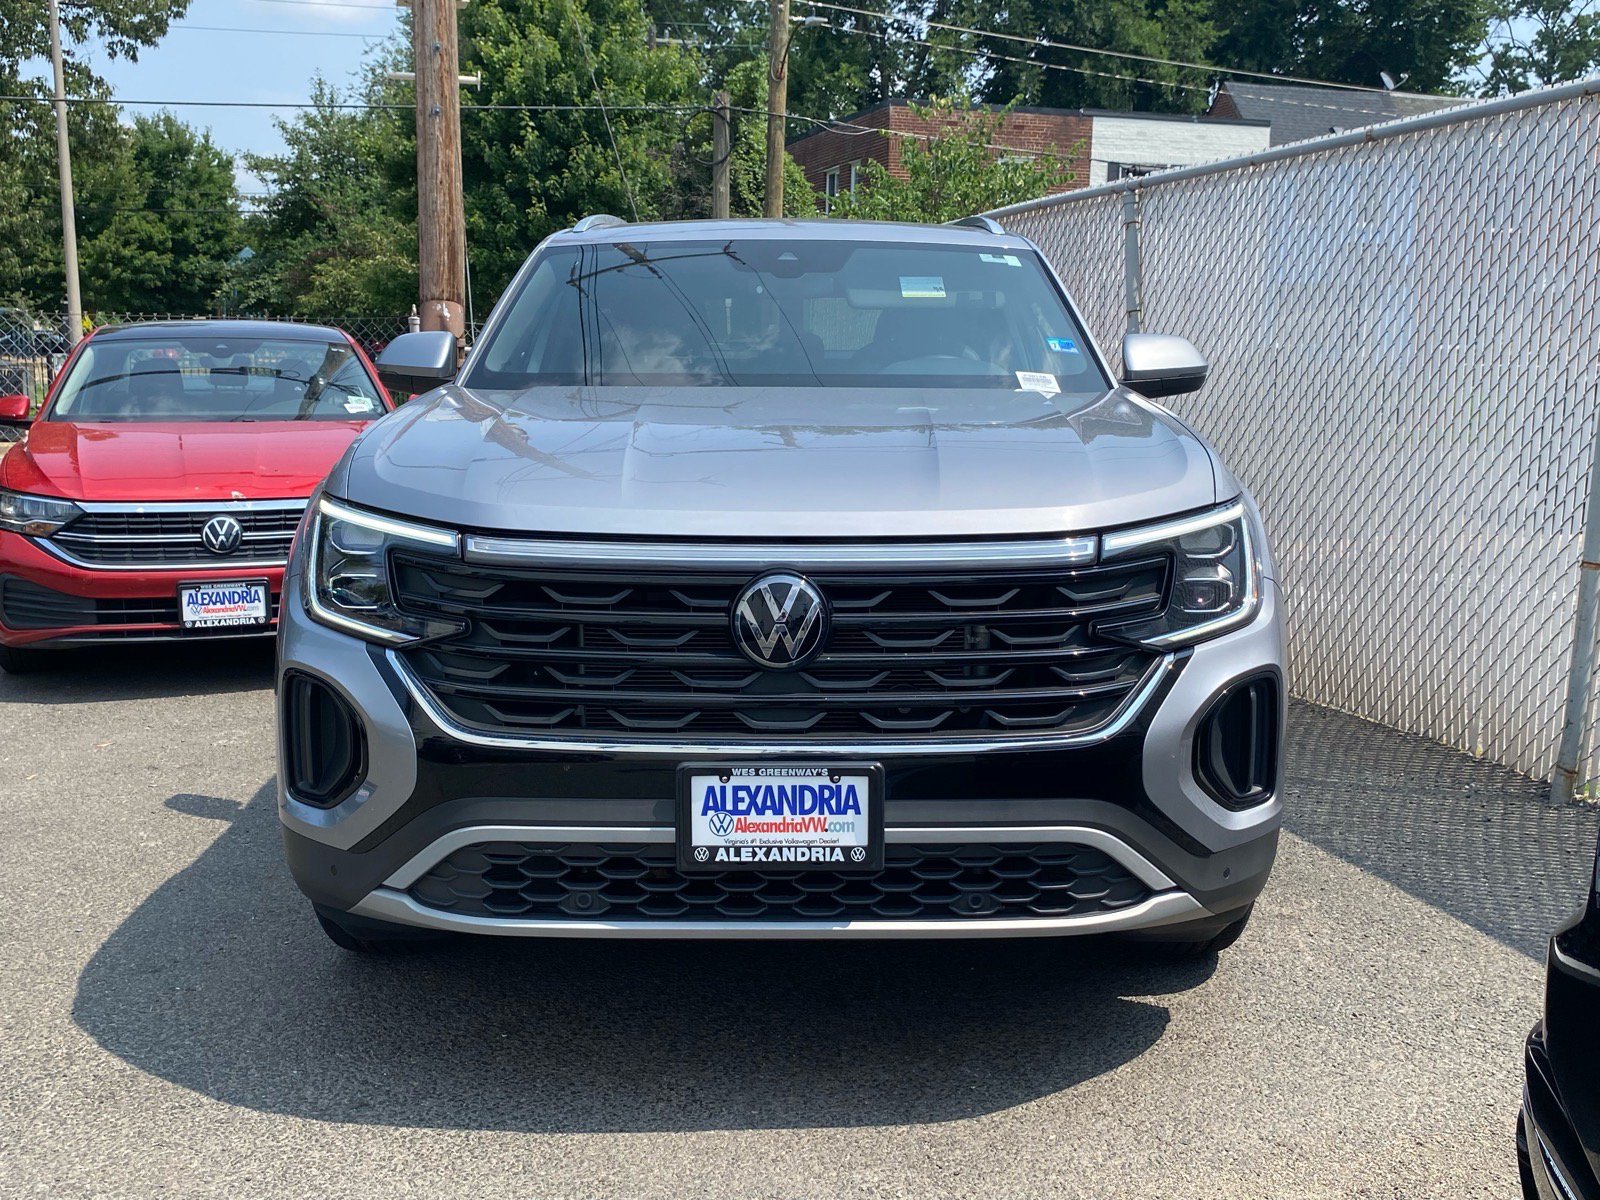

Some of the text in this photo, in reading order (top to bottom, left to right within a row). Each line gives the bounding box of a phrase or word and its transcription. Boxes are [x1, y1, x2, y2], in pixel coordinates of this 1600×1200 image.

[187, 589, 261, 607] ALEXANDRIA
[195, 617, 256, 627] ALEXANDRIA
[739, 580, 820, 660] VW
[731, 768, 829, 776] WES GREENWAY'S
[701, 784, 862, 816] ALEXANDRIA
[734, 816, 855, 833] AlexandriaVW.com
[715, 847, 845, 862] ALEXANDRIA
